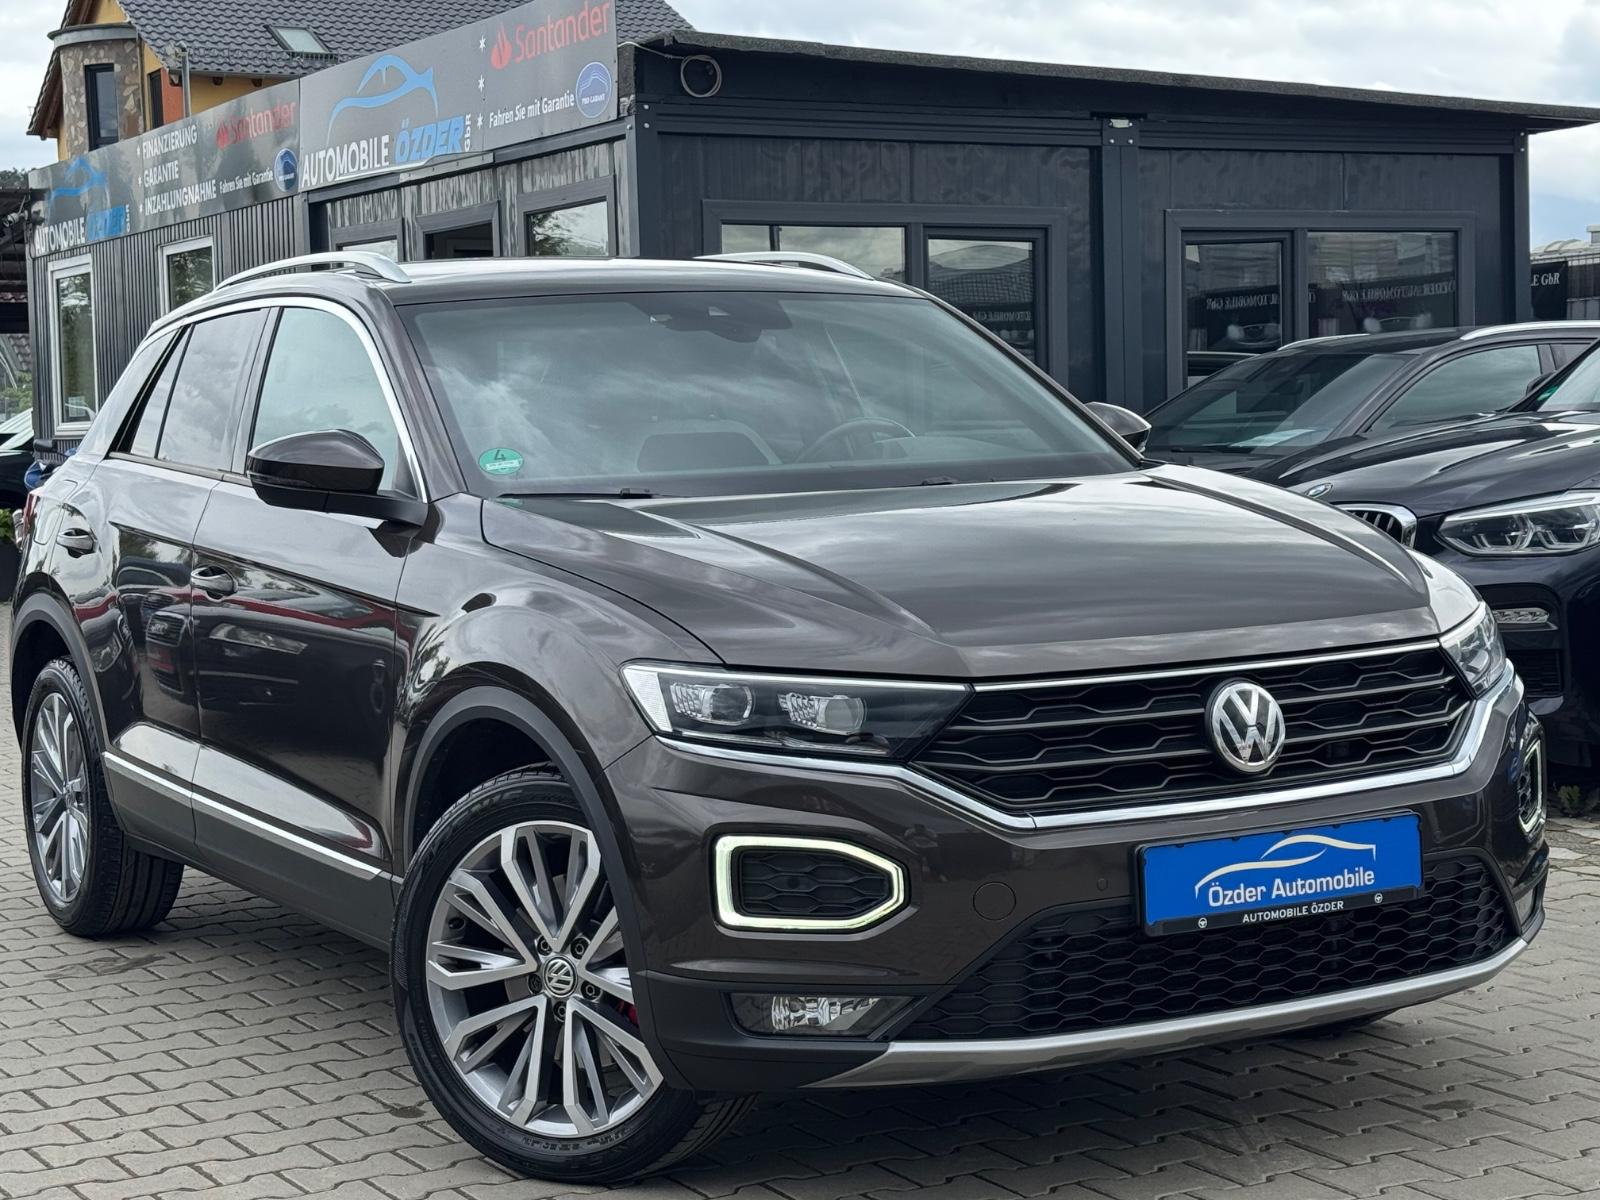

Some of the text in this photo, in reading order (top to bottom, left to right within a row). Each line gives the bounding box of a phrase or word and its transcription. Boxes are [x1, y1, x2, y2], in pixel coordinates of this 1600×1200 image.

[514, 0, 610, 63] Santander
[489, 89, 575, 128] Fahren Sie mit Garantie
[143, 125, 197, 159] FINANZIERUNG
[302, 114, 472, 188] AUTOMOBILE ÖZDER GbR
[143, 160, 179, 187] GARANTIE
[145, 179, 217, 216] INZAHLUNGNAHME
[34, 216, 85, 256] AUTOMOBILE
[1541, 272, 1560, 286] GbR
[494, 449, 506, 461] 4
[1208, 866, 1375, 907] Özder Automobile
[1242, 901, 1344, 923] AUTOMOBILE ÖZDER
